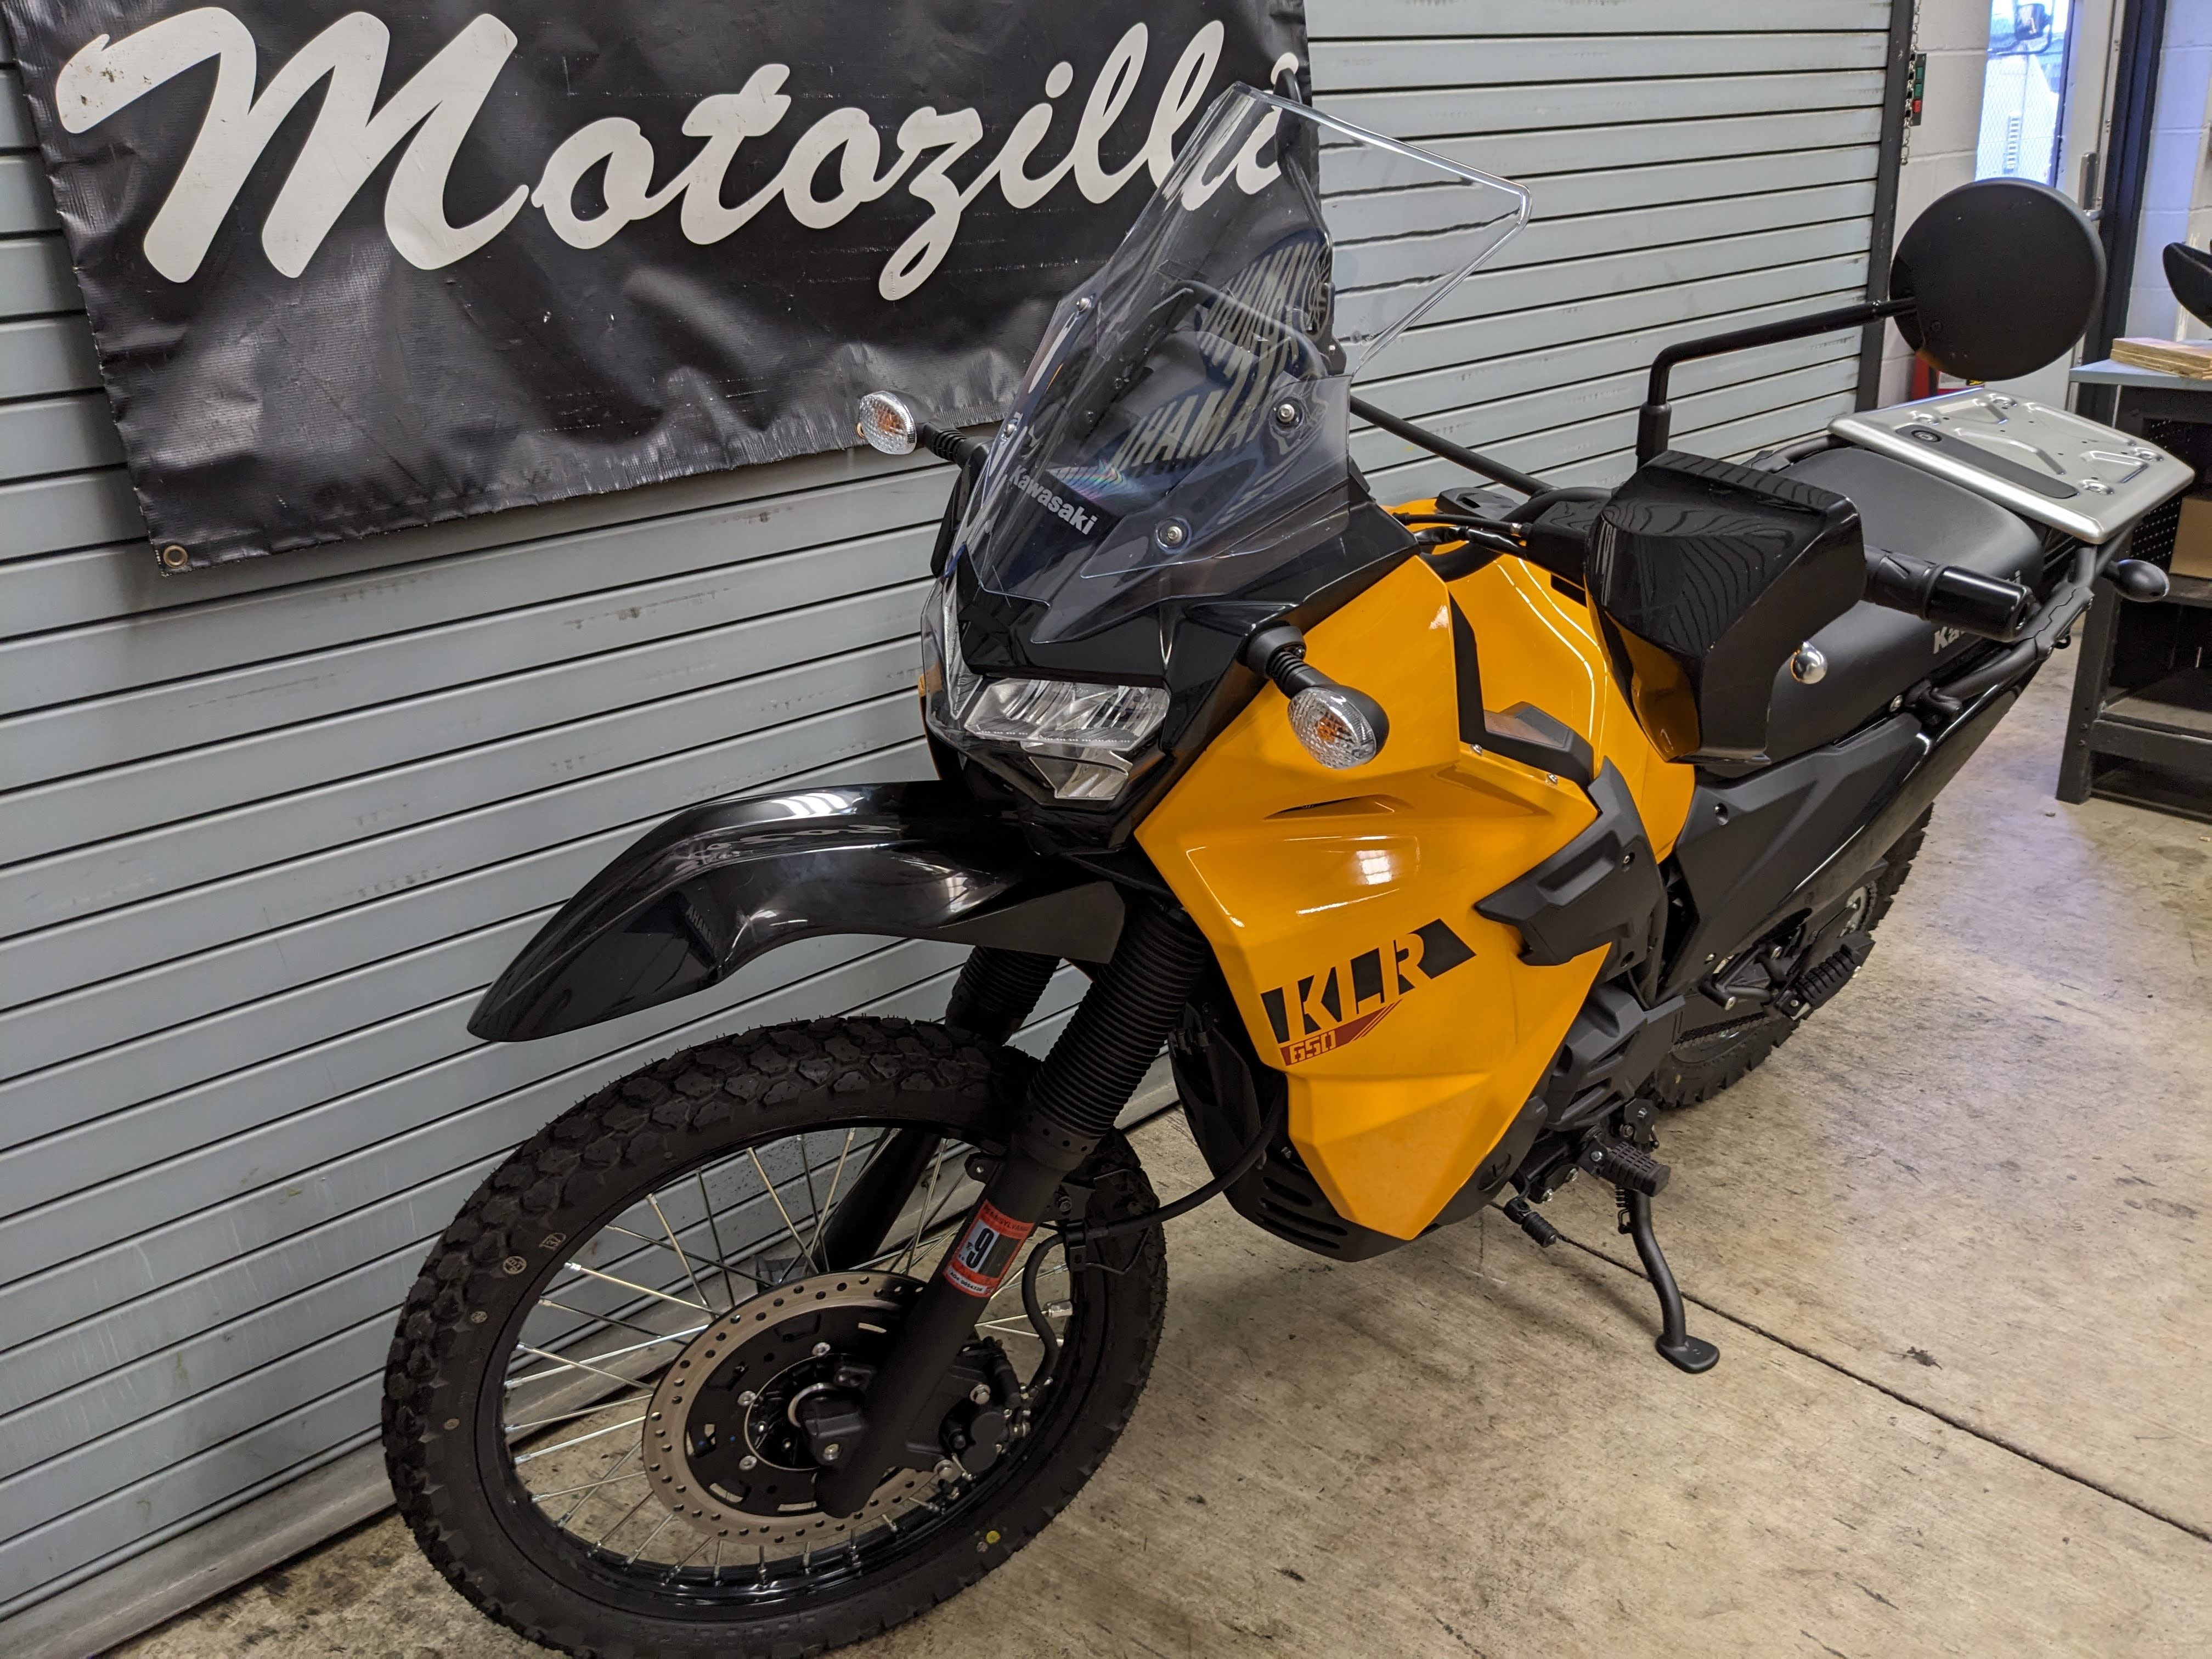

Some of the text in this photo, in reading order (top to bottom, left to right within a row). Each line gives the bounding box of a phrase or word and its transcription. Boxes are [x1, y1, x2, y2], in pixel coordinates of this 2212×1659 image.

[1009, 465, 1098, 535] Kawasaki
[1282, 933, 1433, 1041] KLR
[1290, 1030, 1336, 1064] 650
[966, 1227, 994, 1269] 9
